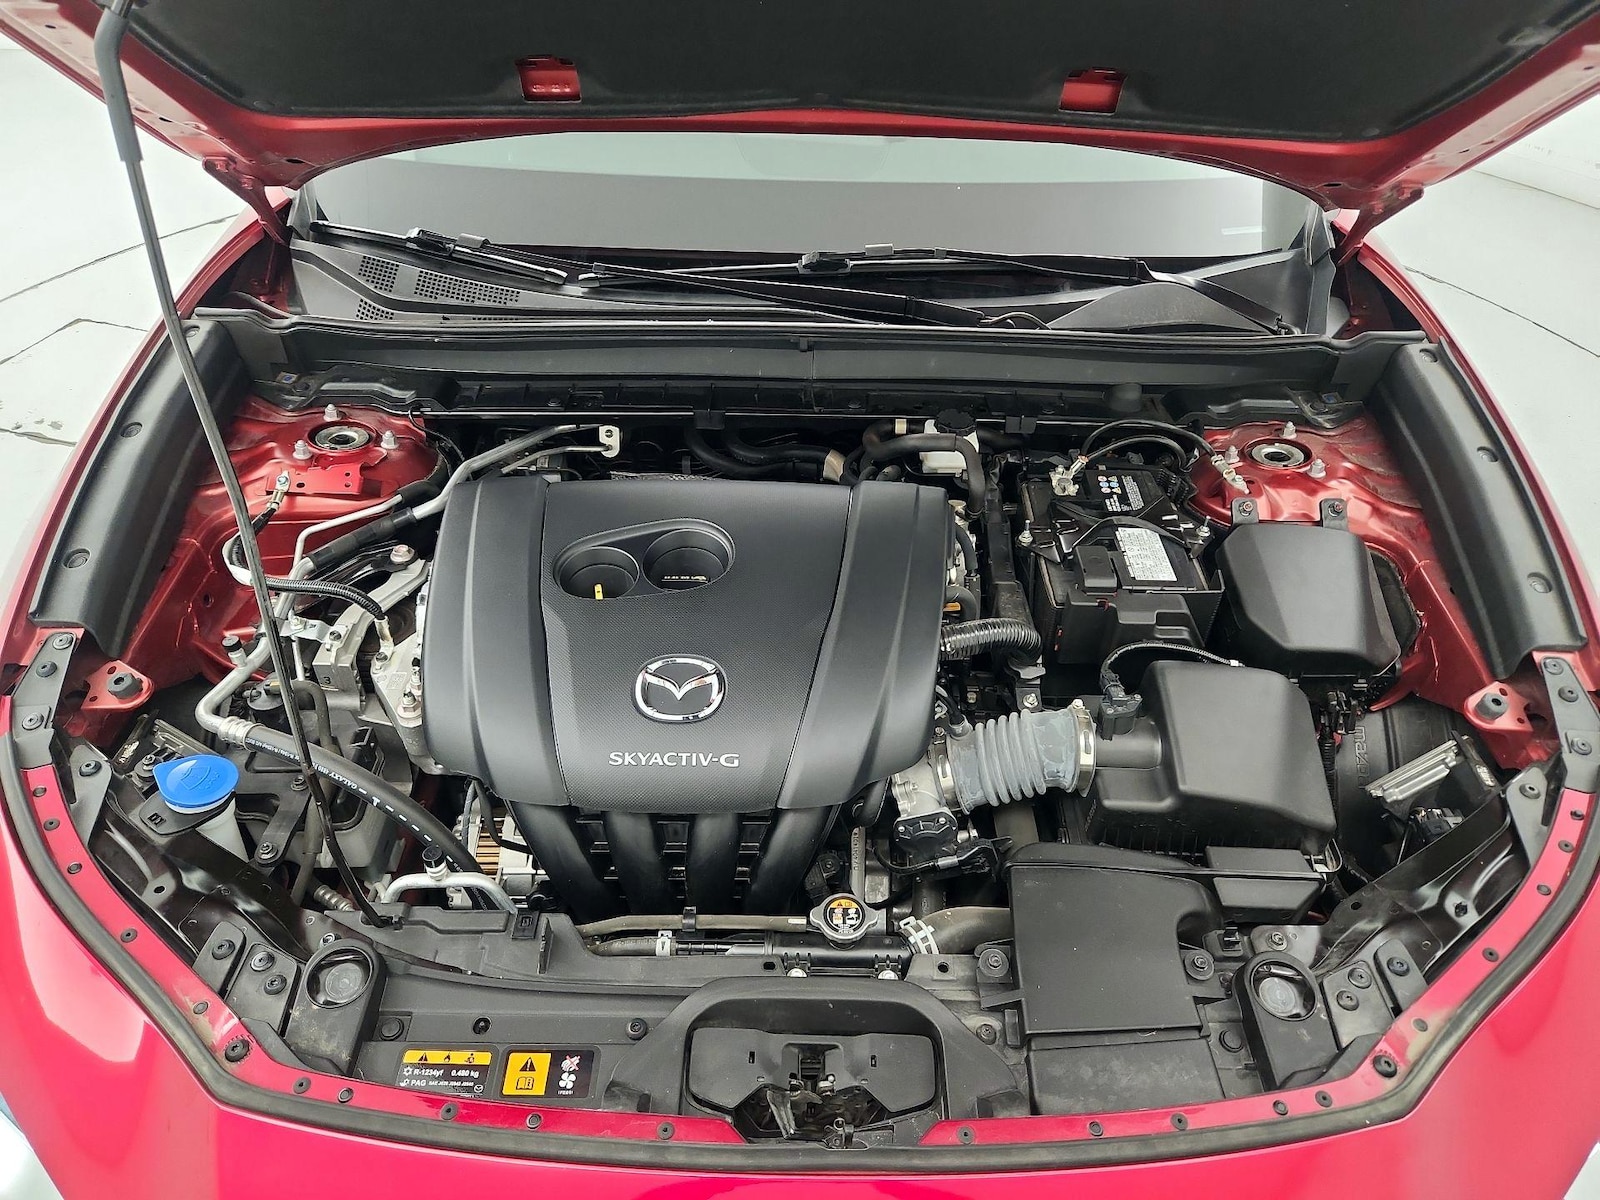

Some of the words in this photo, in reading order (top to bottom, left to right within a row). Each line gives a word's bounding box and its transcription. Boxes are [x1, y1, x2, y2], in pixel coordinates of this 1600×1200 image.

[323, 676, 332, 685] 3
[608, 751, 740, 768] SKYACTIV-G
[328, 770, 358, 790] GALAXY
[413, 1068, 444, 1077] R-1234yf
[470, 1070, 479, 1078] kg
[410, 1079, 426, 1087] PAG
